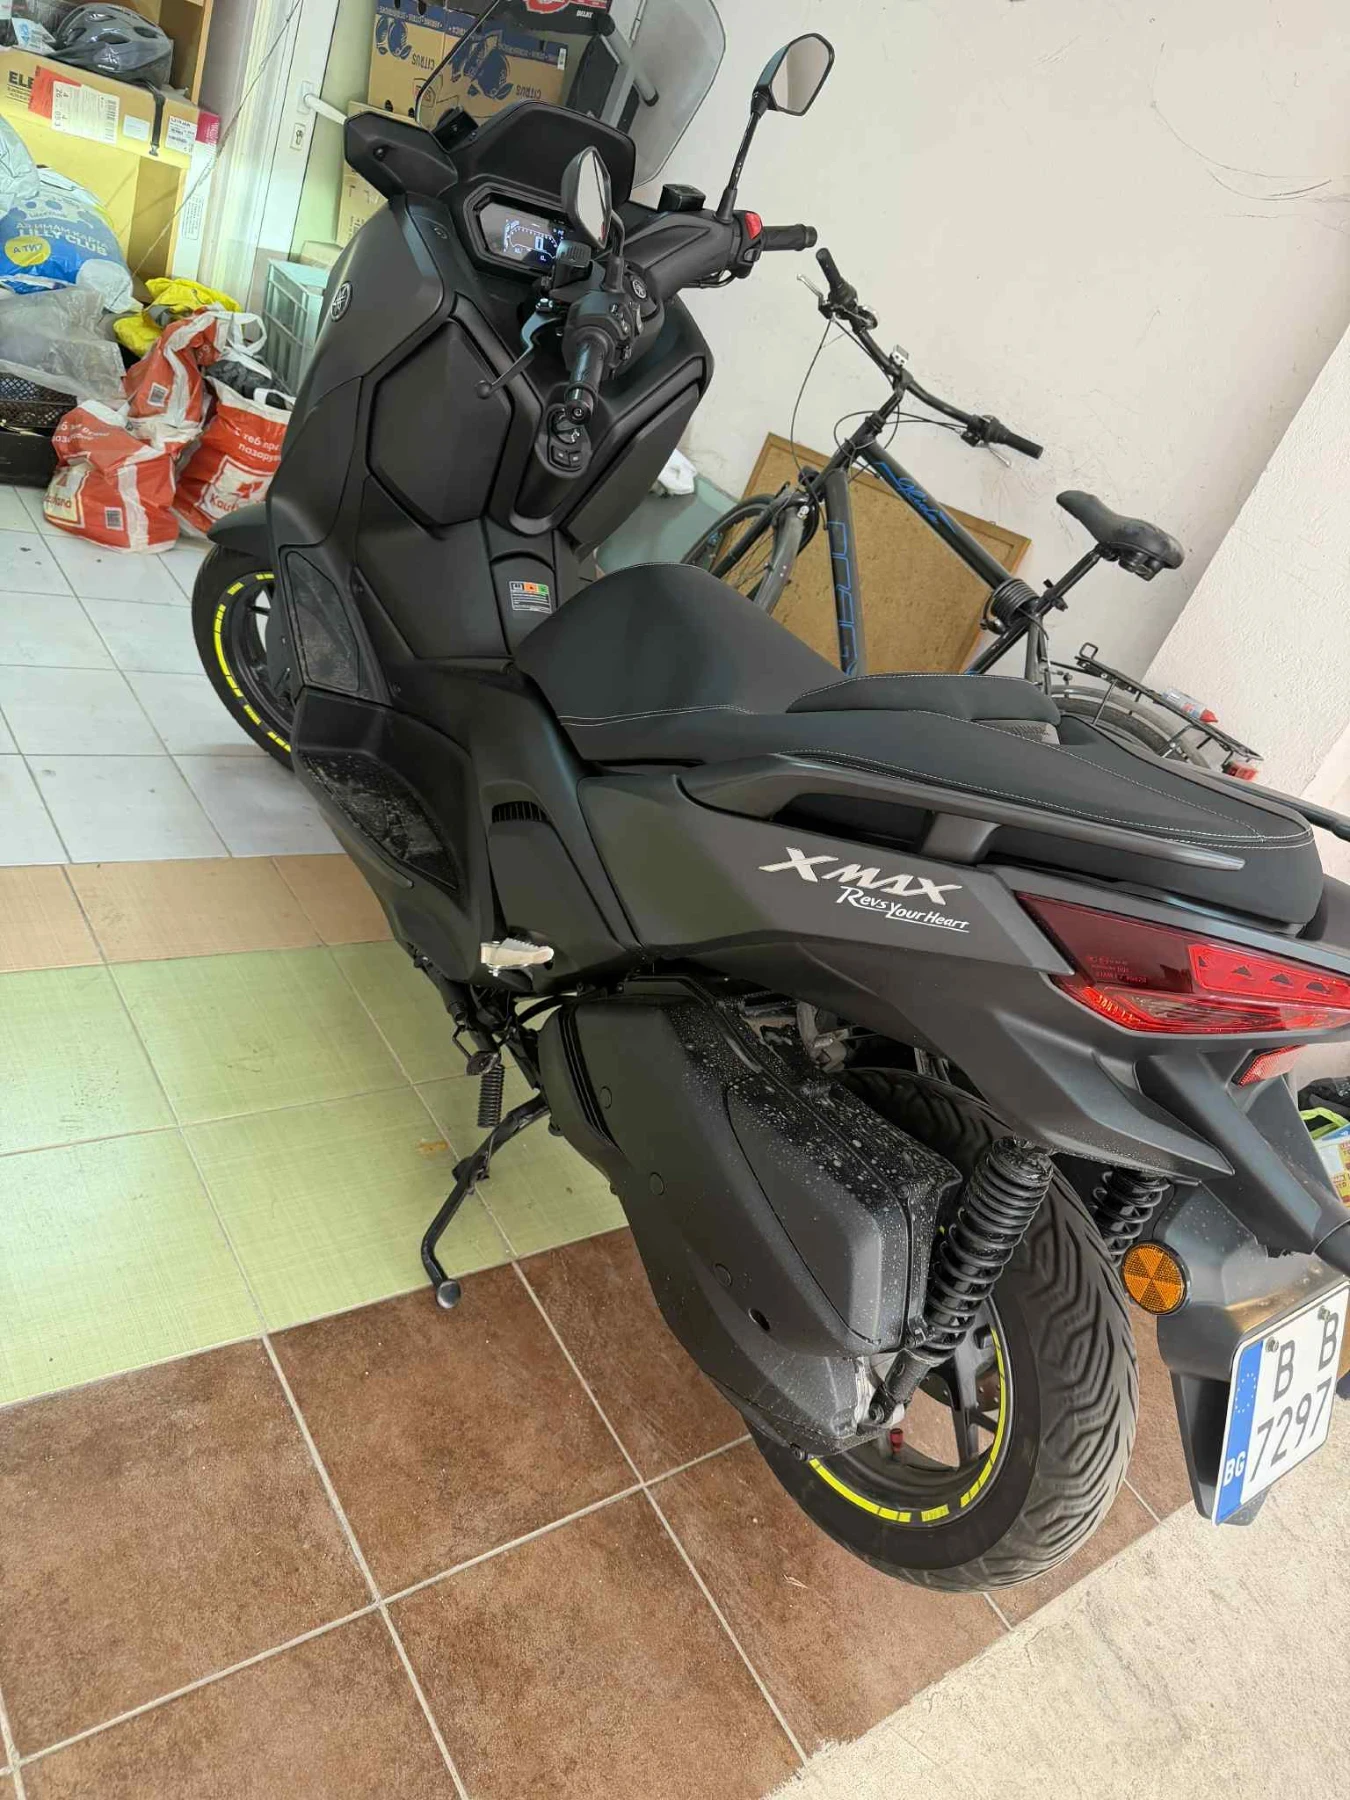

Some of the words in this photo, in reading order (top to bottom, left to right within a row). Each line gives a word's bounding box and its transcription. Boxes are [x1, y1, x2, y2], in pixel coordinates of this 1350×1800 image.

[835, 885, 888, 910] Revs
[885, 902, 927, 922] Your
[926, 910, 970, 930] Heart
[1250, 1376, 1332, 1482] 7297
[1223, 1455, 1246, 1488] BG
